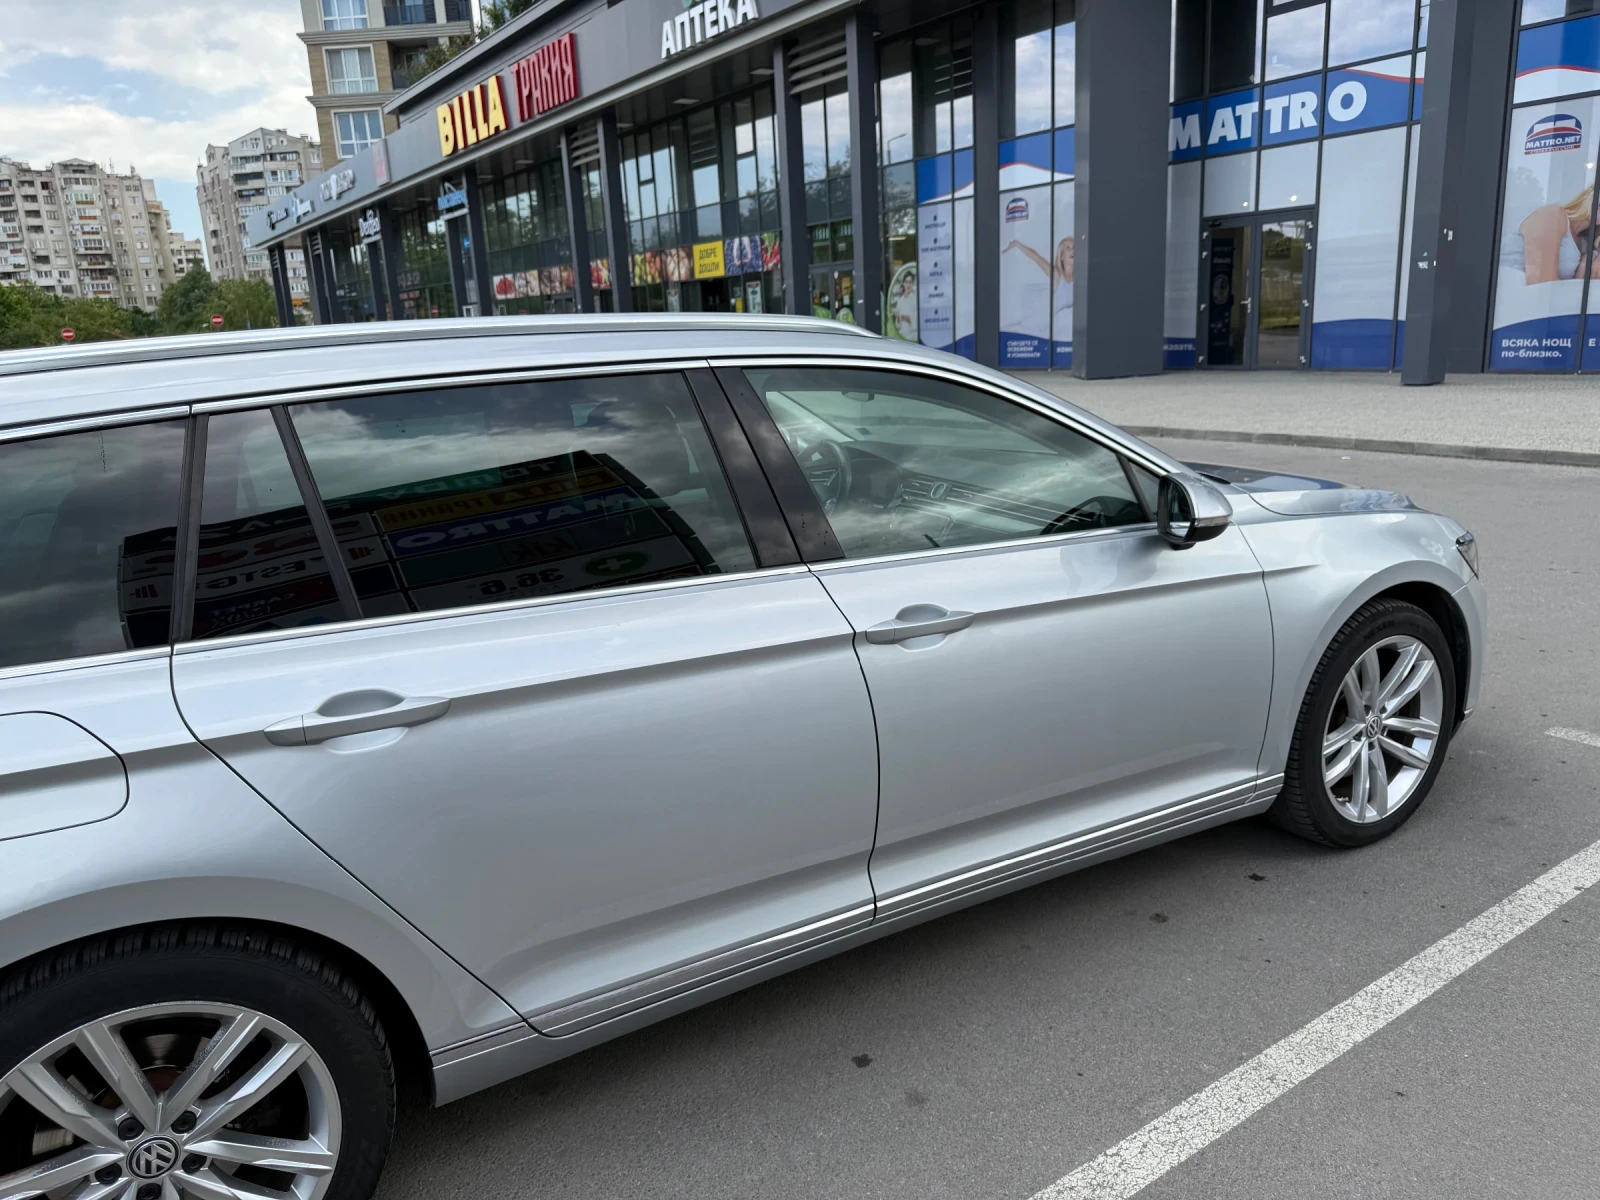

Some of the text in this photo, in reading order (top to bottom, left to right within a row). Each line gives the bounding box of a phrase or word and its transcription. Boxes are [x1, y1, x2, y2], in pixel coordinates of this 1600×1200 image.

[661, 0, 757, 59] АПТЕКА
[510, 33, 577, 122] ТРАКИЯ
[436, 75, 508, 157] BILLA
[1168, 81, 1368, 152] MATTRO
[1526, 135, 1581, 149] MATTRO.NET
[1501, 338, 1539, 347] ВСЯКА
[1541, 338, 1572, 348] НОЩ
[1501, 349, 1563, 358] по-близко.
